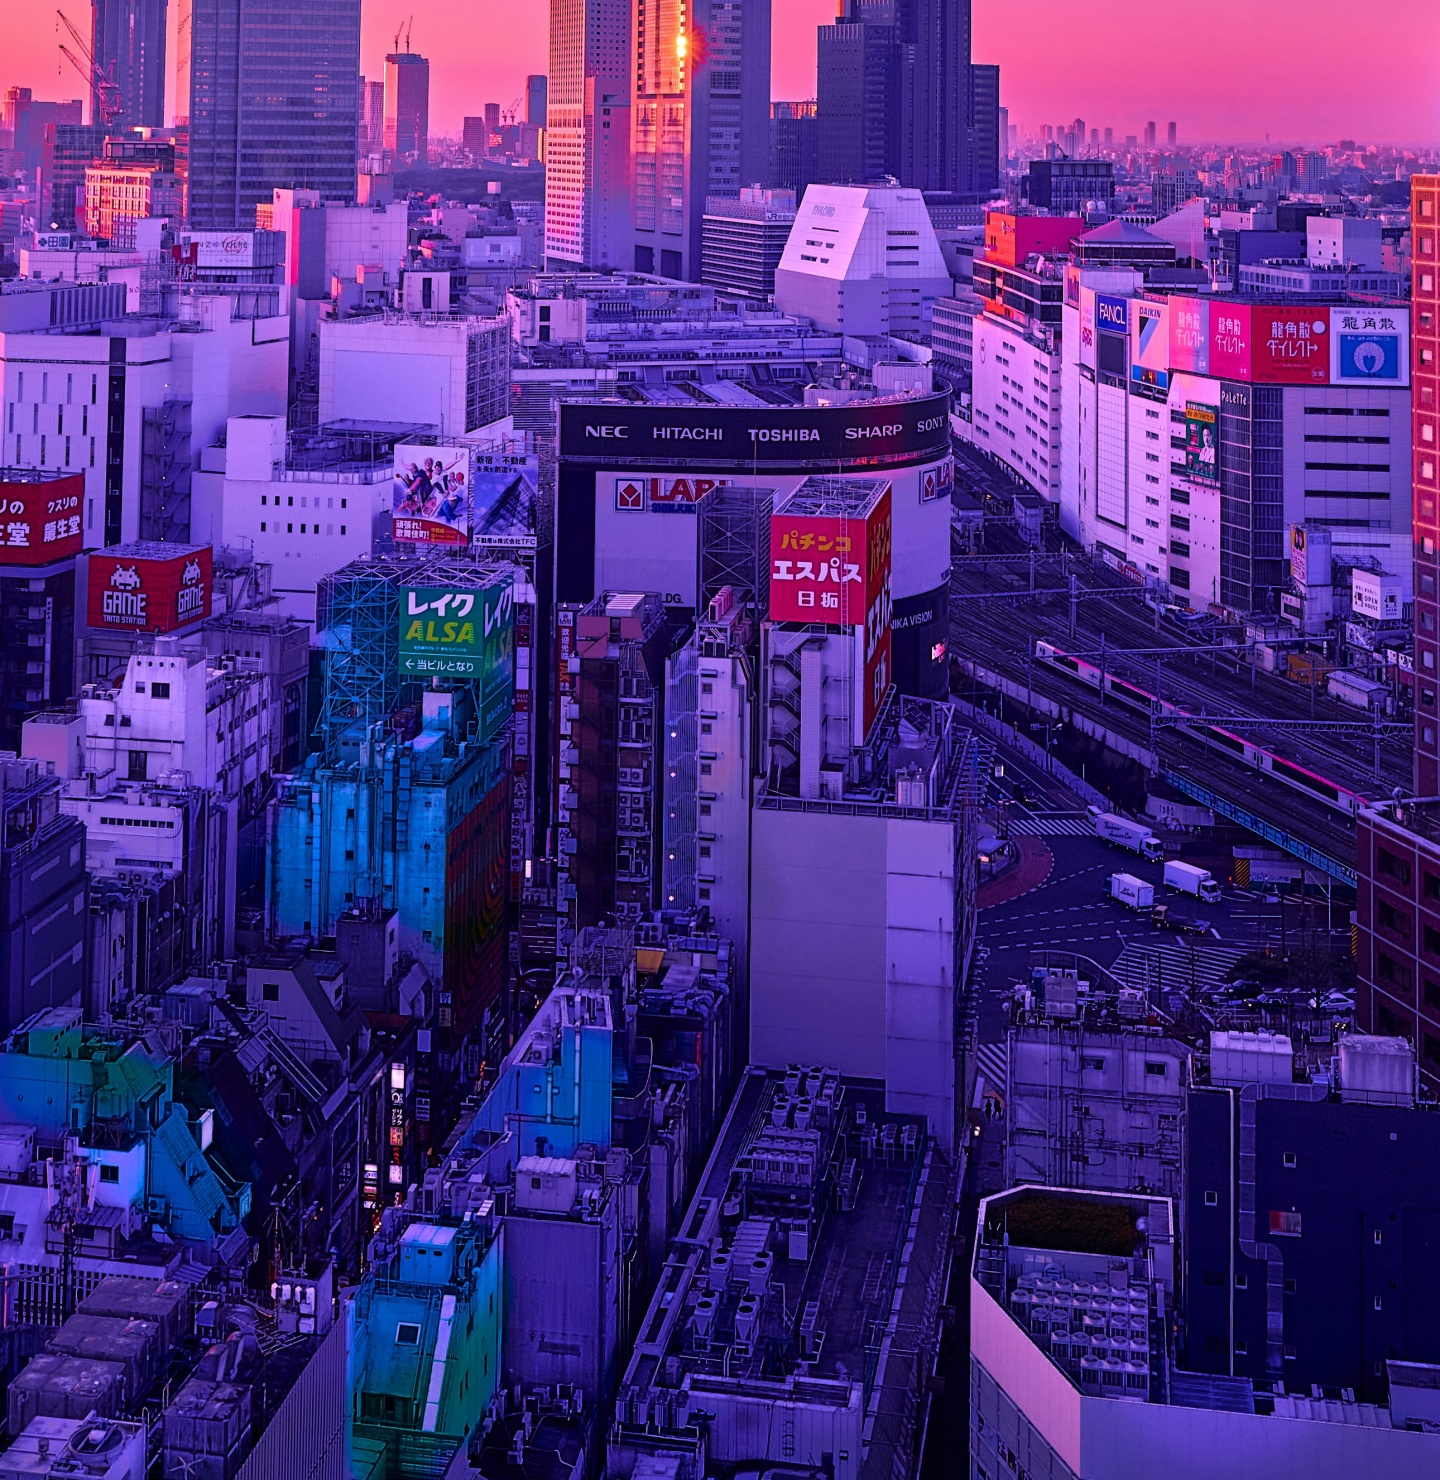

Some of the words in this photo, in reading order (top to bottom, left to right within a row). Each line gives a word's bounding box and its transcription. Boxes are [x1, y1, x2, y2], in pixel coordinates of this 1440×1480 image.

[1100, 303, 1126, 325] FANCL
[1139, 306, 1161, 318] DAIKIN
[1218, 317, 1241, 337] 龍角散
[1271, 321, 1311, 338] 龍角散
[1342, 316, 1397, 331] 龍角散
[1215, 334, 1246, 354] ダイレクト
[1266, 340, 1319, 358] ダイレクト
[585, 425, 629, 438] NEC
[653, 427, 723, 441] HITACHI
[748, 429, 821, 442] TOSHIBA
[845, 424, 903, 439] SHARP
[917, 415, 944, 433] SONY
[476, 456, 493, 464] 新宿
[502, 456, 528, 466] 不動産
[47, 496, 78, 514] クスリの
[43, 515, 80, 542] 龍生堂
[781, 530, 852, 552] パチンコ
[773, 557, 862, 583] エスパス
[103, 590, 146, 616] GAME
[178, 583, 204, 612] GAME
[408, 591, 475, 617] レイク
[1364, 595, 1379, 606] OPEN
[1364, 602, 1379, 611] HOUSE
[103, 615, 120, 624] TAITO
[121, 615, 147, 626] STATION
[909, 609, 933, 627] VISION
[405, 620, 475, 643] ALSA
[417, 659, 474, 672] 当ビルとなり
